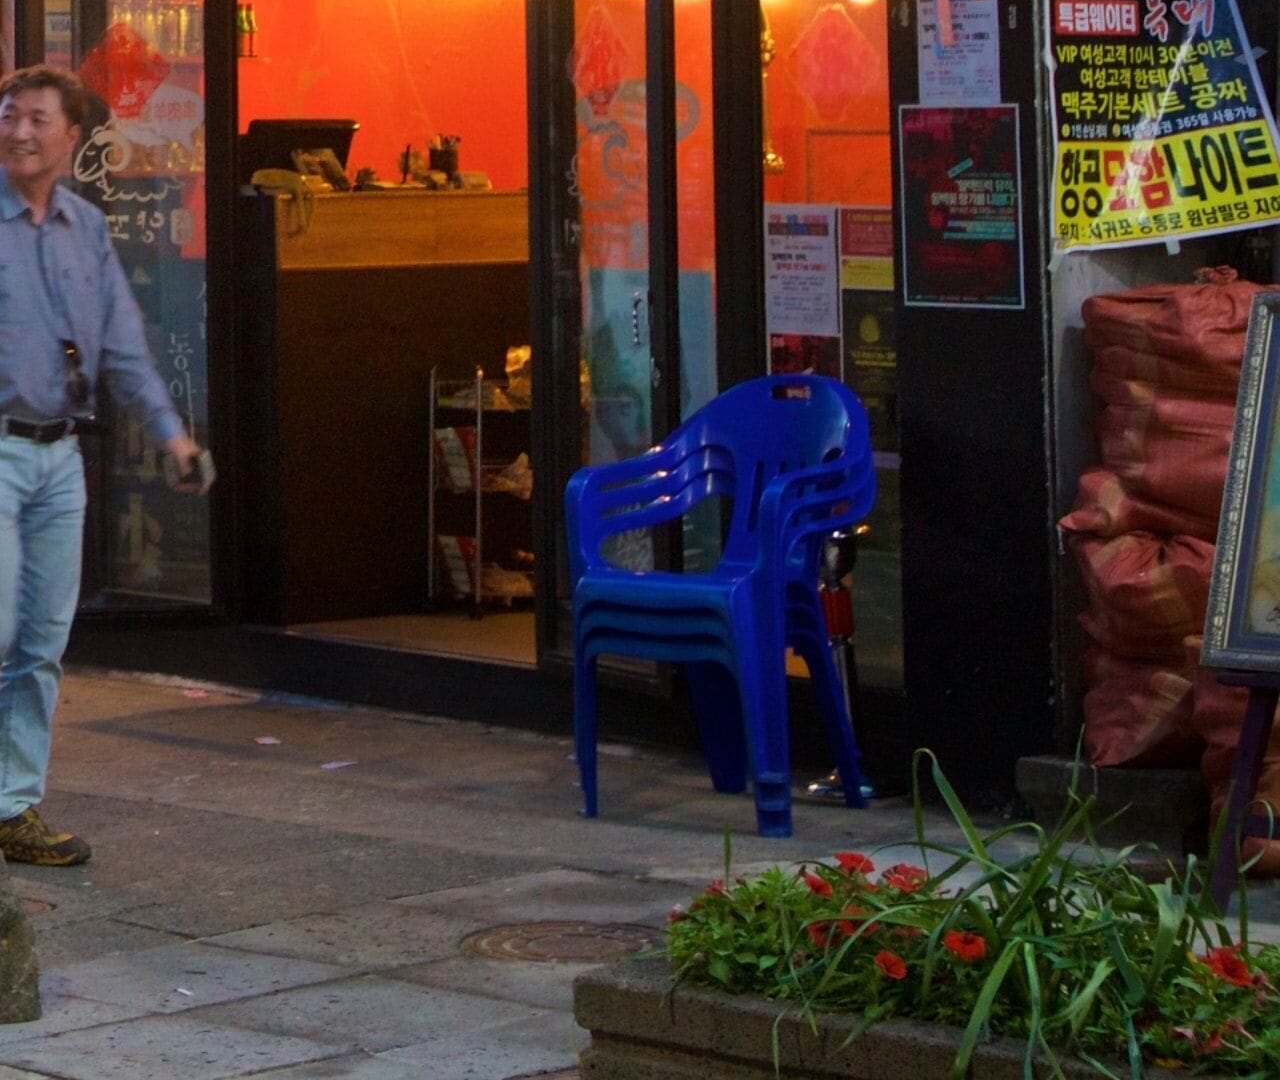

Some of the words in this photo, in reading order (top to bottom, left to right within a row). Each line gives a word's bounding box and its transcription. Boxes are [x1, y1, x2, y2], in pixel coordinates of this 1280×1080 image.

[1058, 1, 1138, 33] 특급웨이터
[1056, 44, 1078, 64] VIP
[1080, 44, 1128, 67] 여성고객
[1129, 45, 1155, 66] 10시
[1080, 67, 1132, 89] 여성고객
[1190, 77, 1249, 110] 공짜
